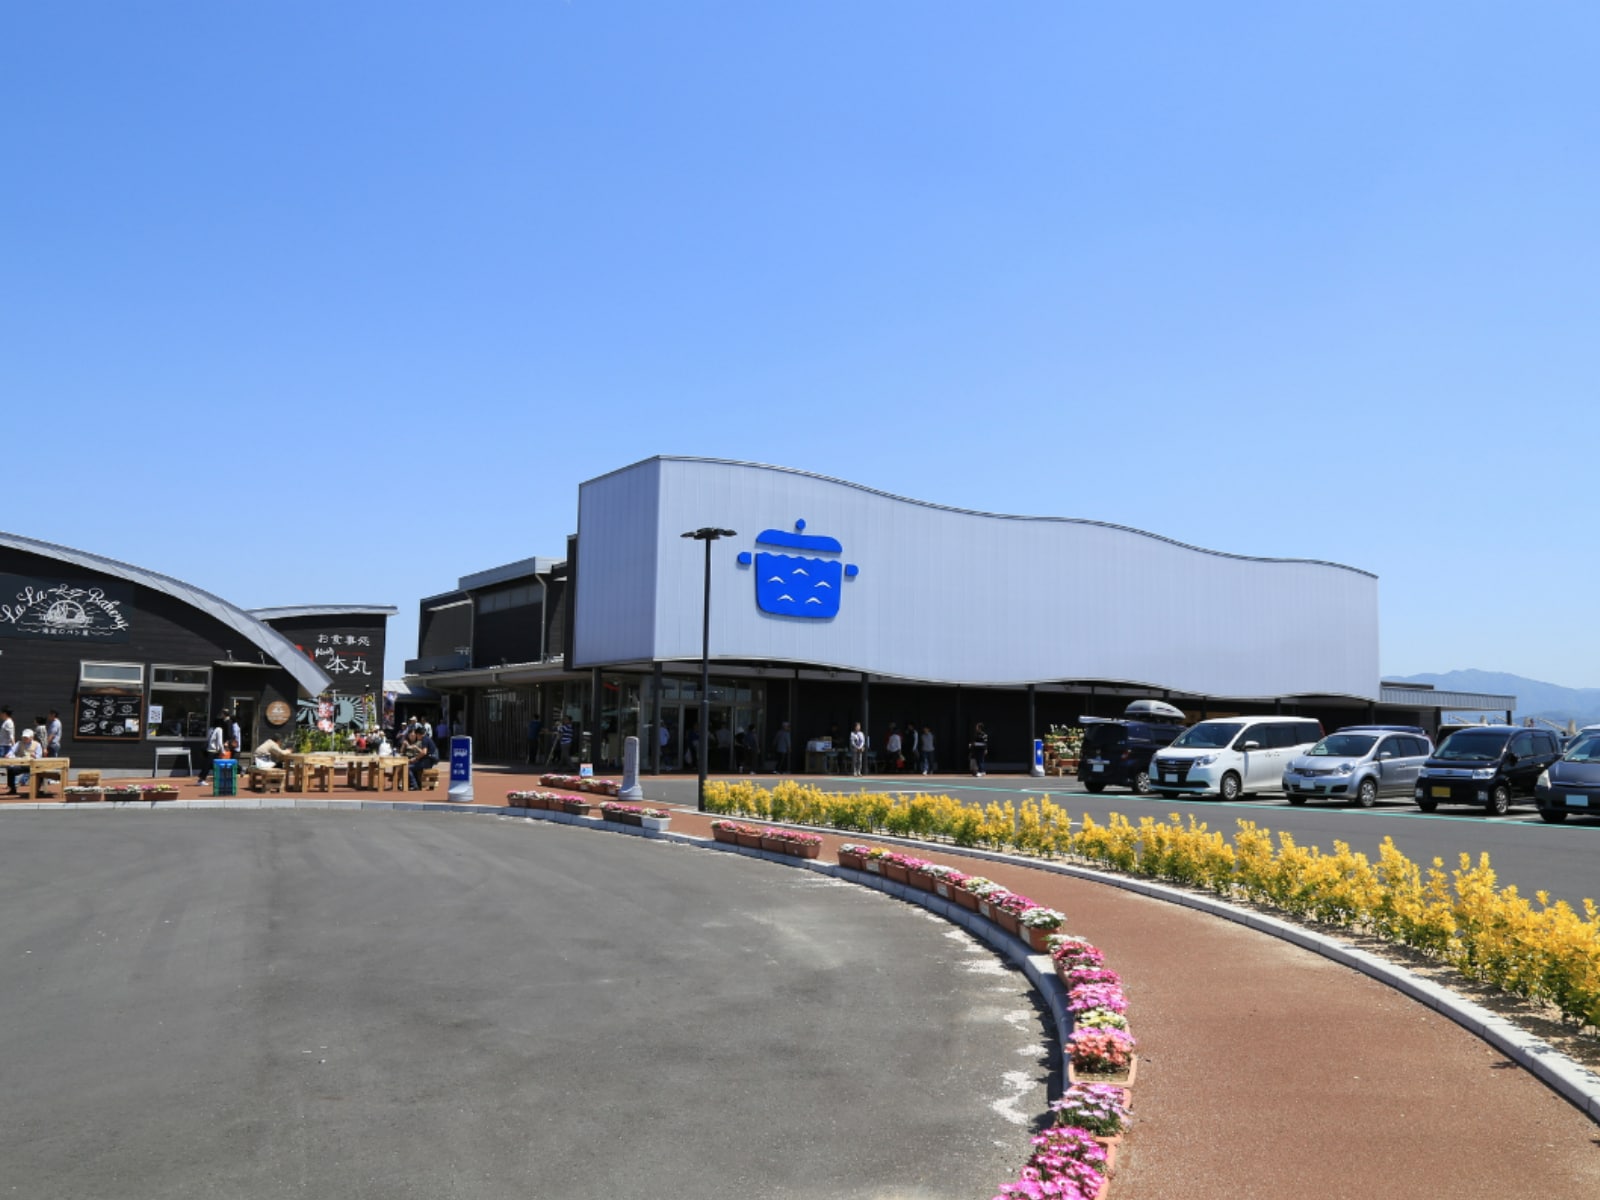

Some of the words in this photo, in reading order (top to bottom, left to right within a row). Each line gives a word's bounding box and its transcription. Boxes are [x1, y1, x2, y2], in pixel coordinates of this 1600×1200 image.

[88, 587, 129, 631] Bakery
[318, 634, 371, 646] お食事処
